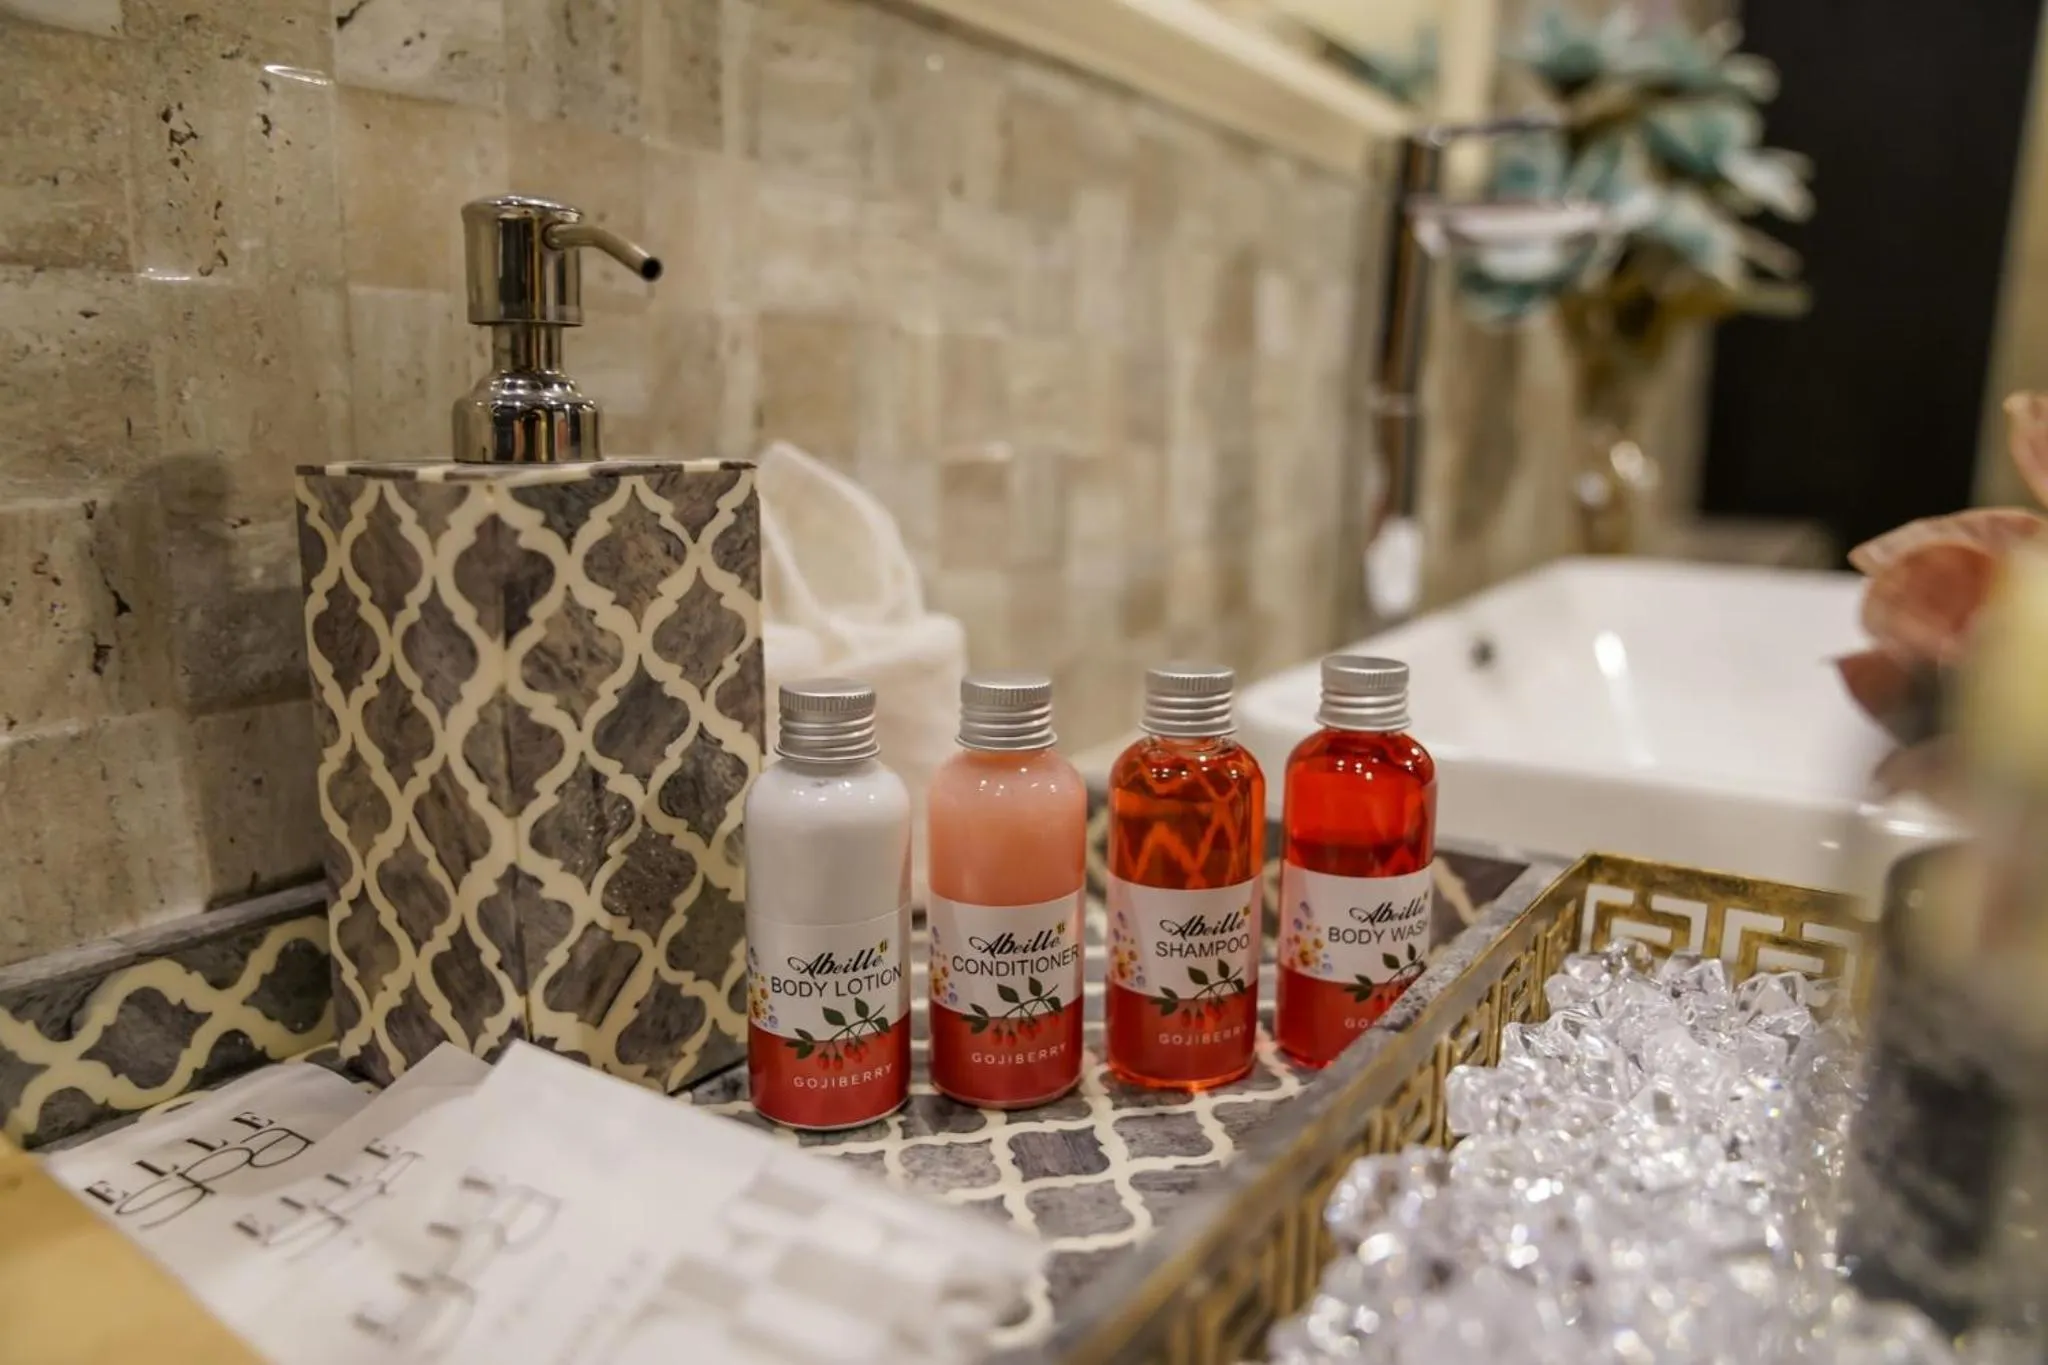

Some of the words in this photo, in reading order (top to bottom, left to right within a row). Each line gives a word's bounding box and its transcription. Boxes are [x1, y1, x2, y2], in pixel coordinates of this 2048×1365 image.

[1159, 911, 1246, 942] Abeille
[1327, 926, 1385, 945] BODY
[968, 928, 1061, 958] Abeille
[1155, 932, 1250, 958] SHAMPOO
[787, 947, 883, 979] Abeille
[951, 942, 1080, 978] CONDITIONER
[770, 976, 826, 998] BODY
[835, 961, 903, 998] LOTION
[971, 1042, 1067, 1065] GOJIBERRY
[792, 1063, 893, 1090] GOJIBERRY
[84, 1111, 275, 1205] ELLE
